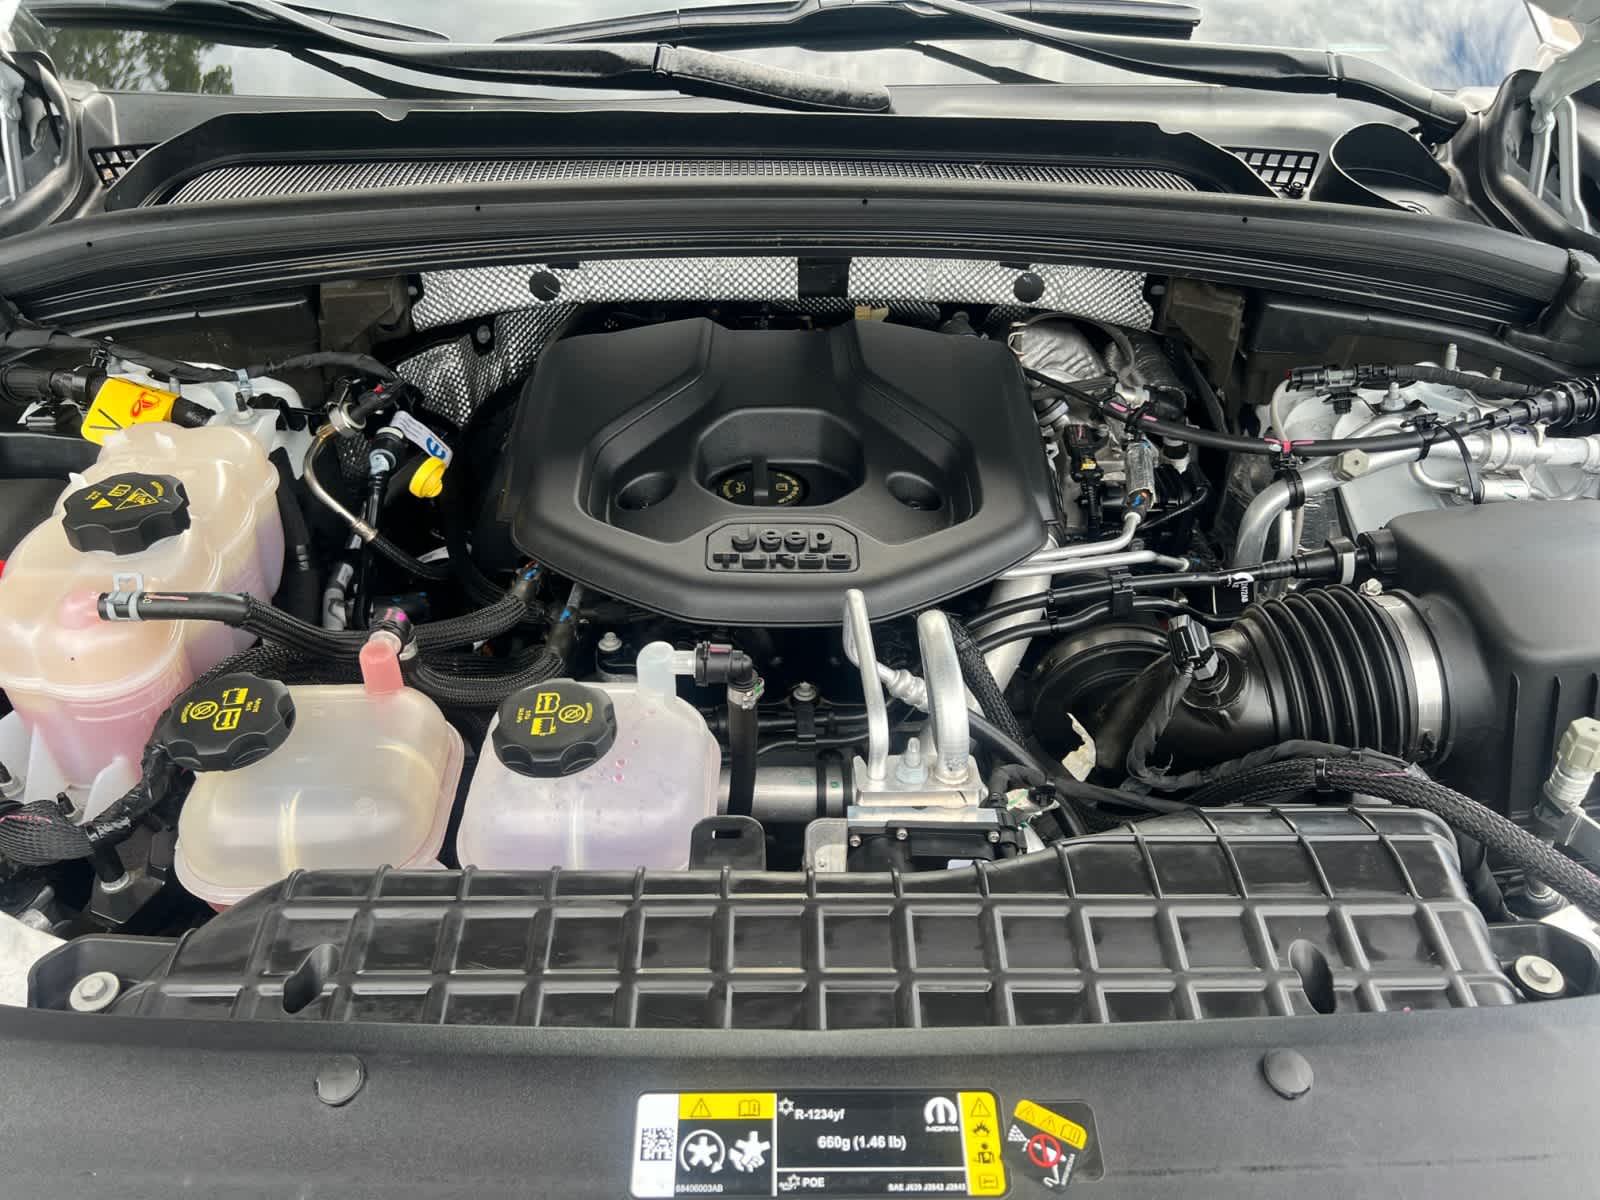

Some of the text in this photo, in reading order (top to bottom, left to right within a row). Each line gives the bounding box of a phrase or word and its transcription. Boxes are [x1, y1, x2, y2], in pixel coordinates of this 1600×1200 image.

[731, 526, 832, 553] Jeep
[794, 1108, 846, 1122] R-1234yf
[817, 1135, 907, 1152] 660g (1.46 lb)
[802, 1177, 825, 1188] POE
